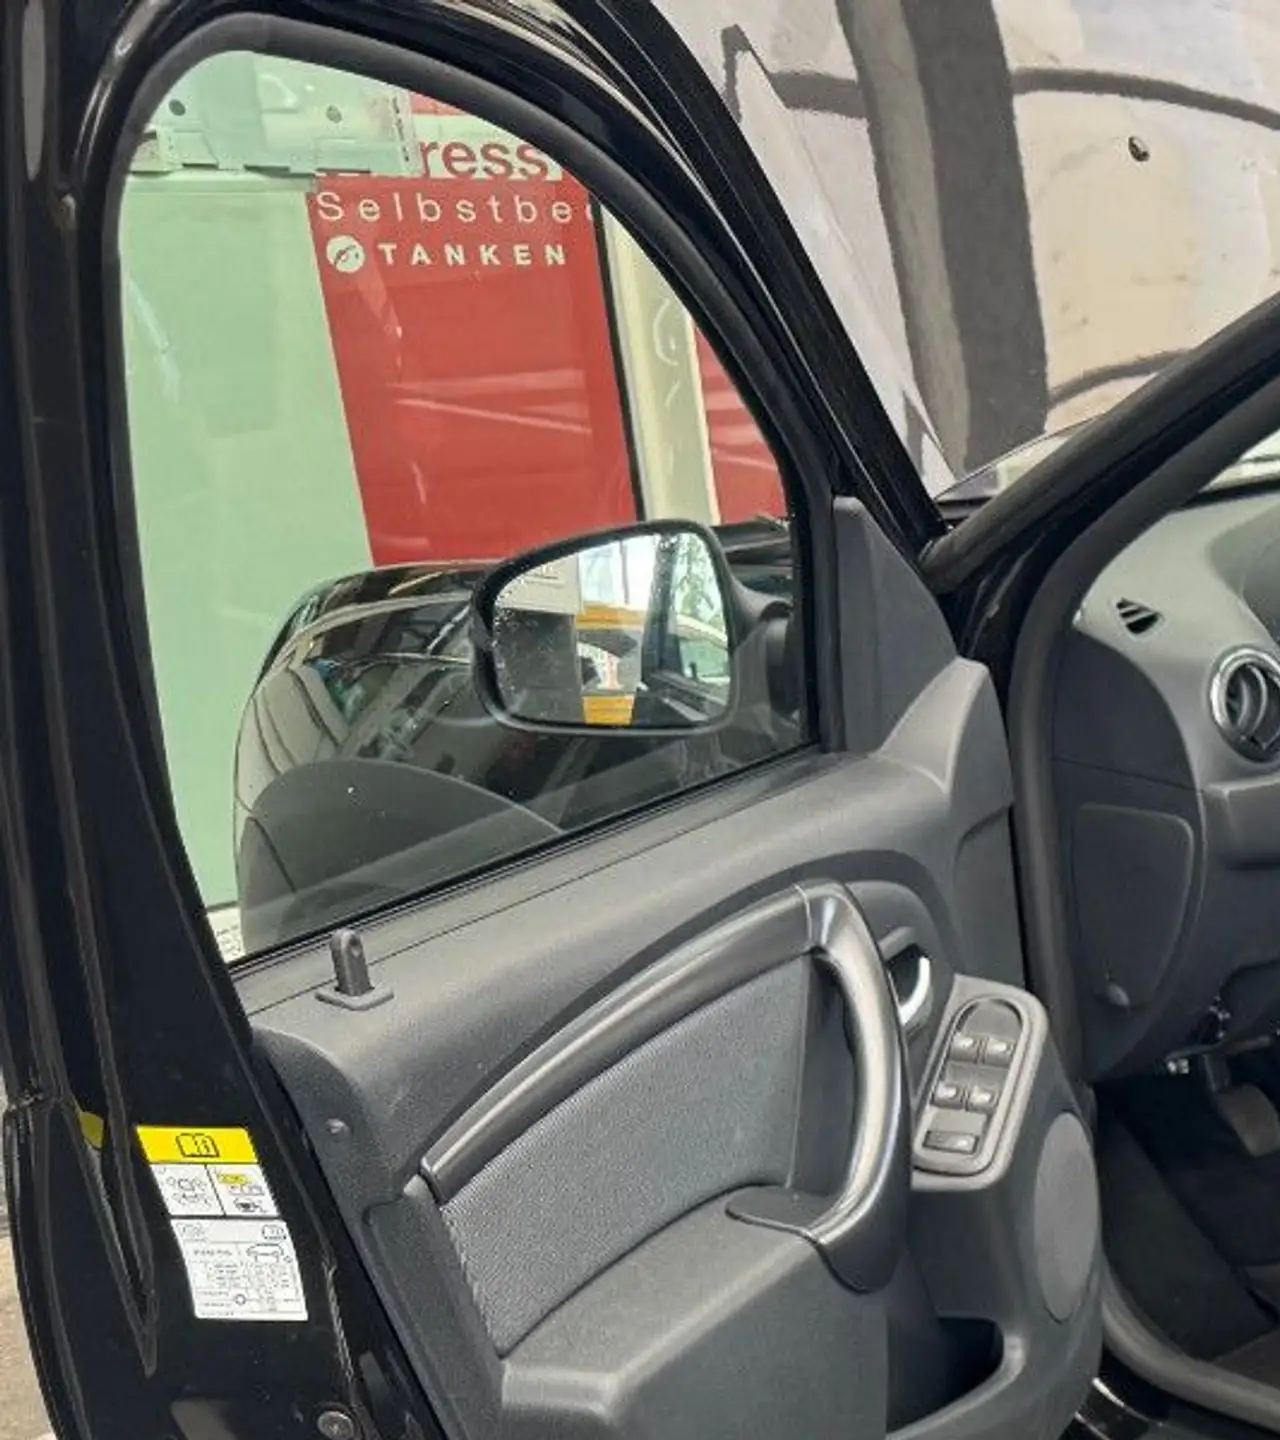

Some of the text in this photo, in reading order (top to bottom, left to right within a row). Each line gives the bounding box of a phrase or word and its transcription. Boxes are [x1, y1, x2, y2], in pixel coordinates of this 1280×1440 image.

[418, 139, 549, 178] ress
[315, 191, 593, 223] Selbstbe
[377, 243, 567, 266] TANKEN
